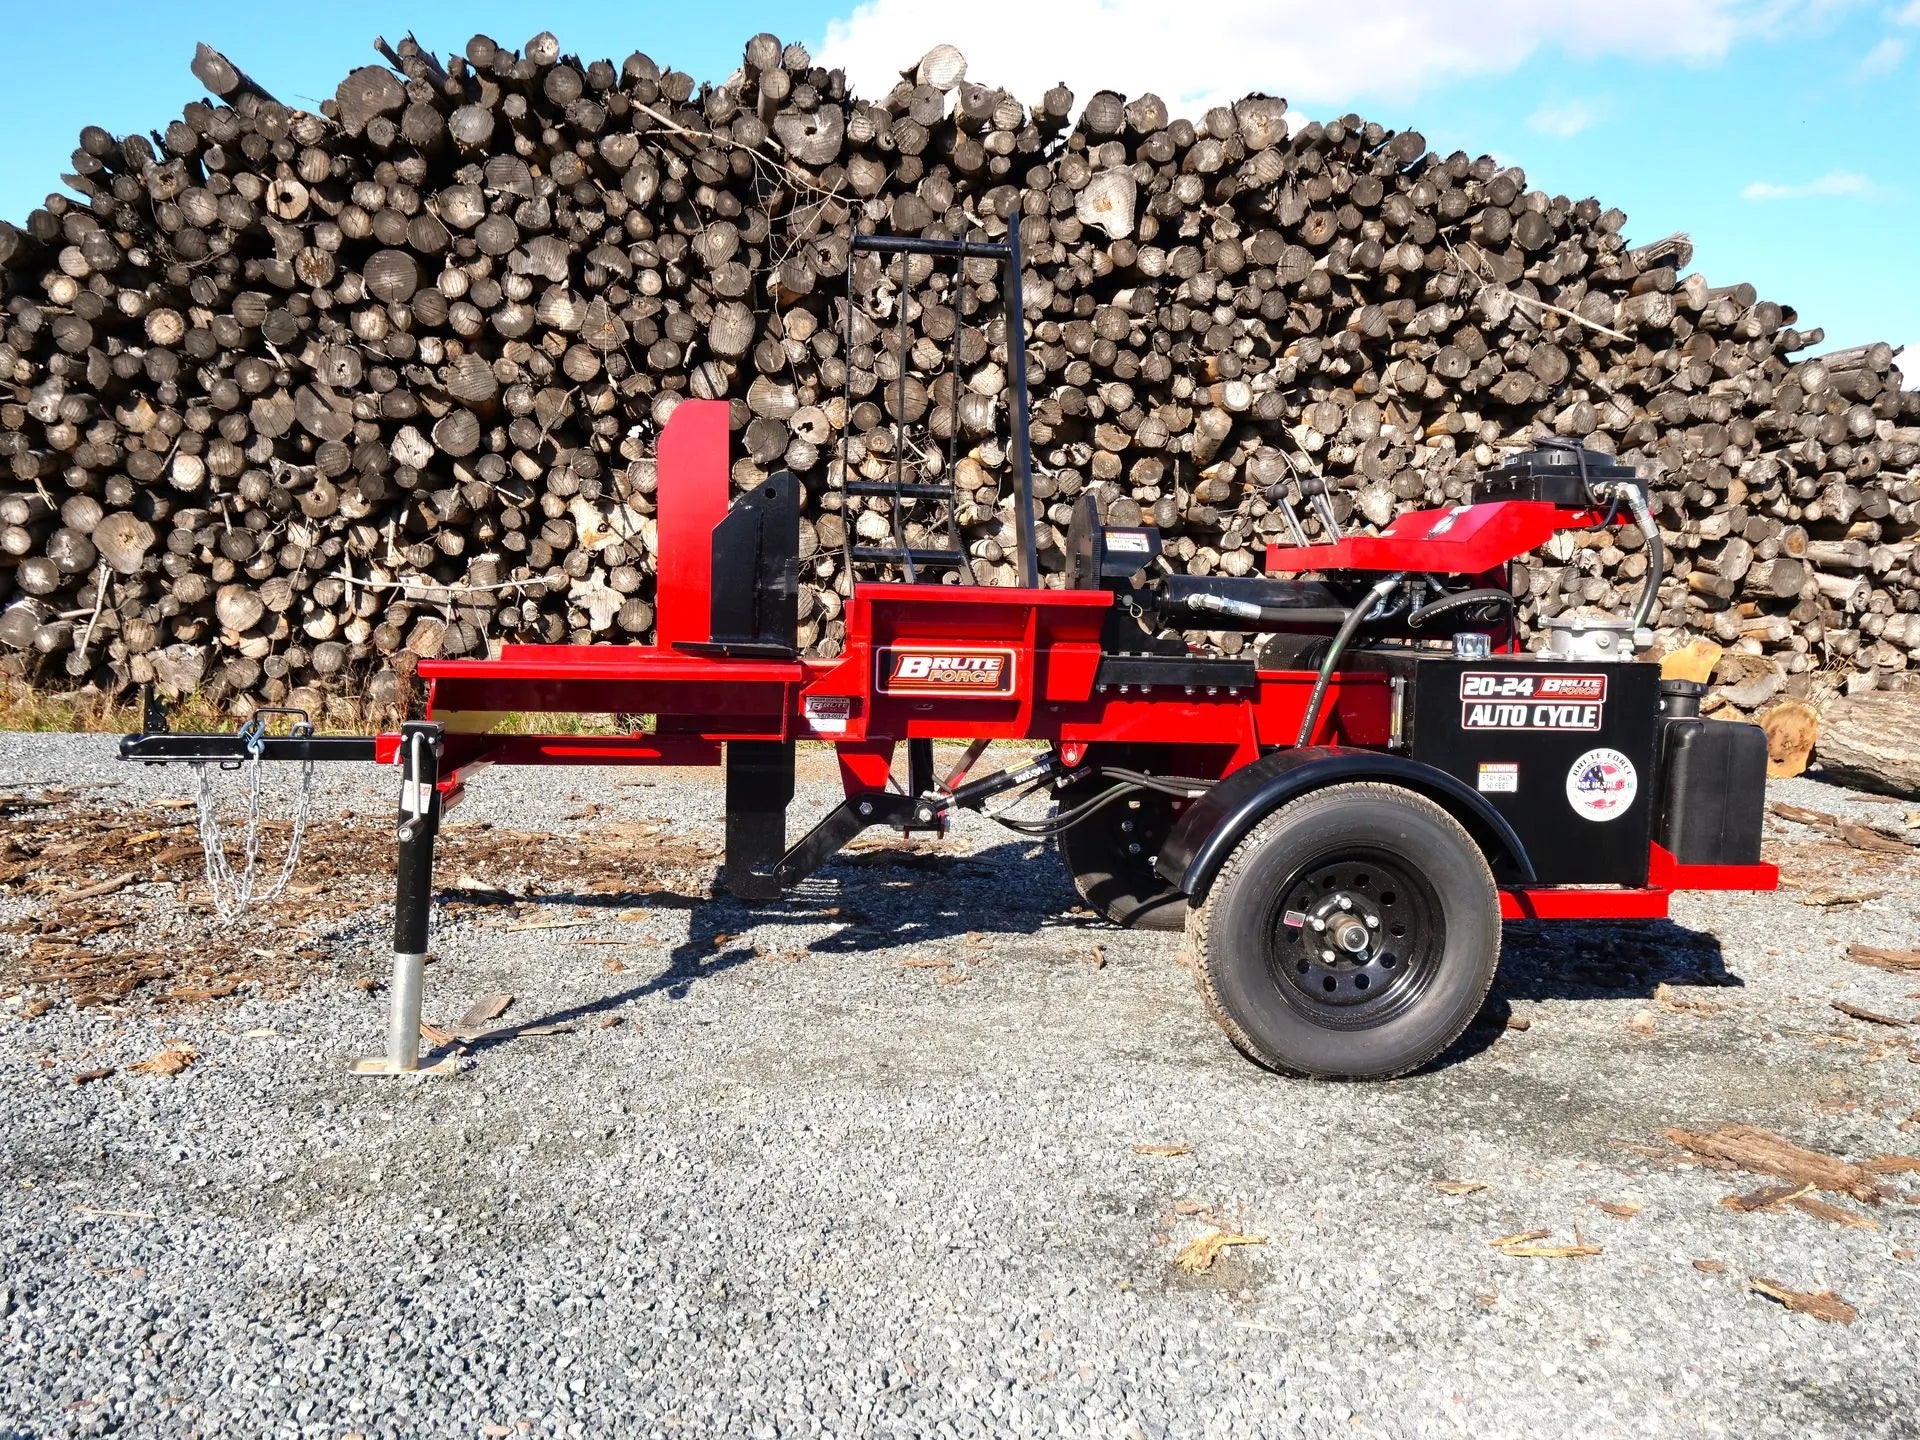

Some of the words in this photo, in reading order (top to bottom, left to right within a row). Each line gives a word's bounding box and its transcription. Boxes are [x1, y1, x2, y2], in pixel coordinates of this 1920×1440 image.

[897, 656, 1002, 678] BRUTE
[928, 669, 999, 682] FORCE
[1463, 676, 1534, 697] 20-24
[1543, 679, 1602, 692] BRUTE
[1559, 687, 1601, 695] FORCE
[1467, 704, 1528, 727] AUTO
[1533, 705, 1598, 728] CYCLE
[1487, 763, 1518, 772] WARNING
